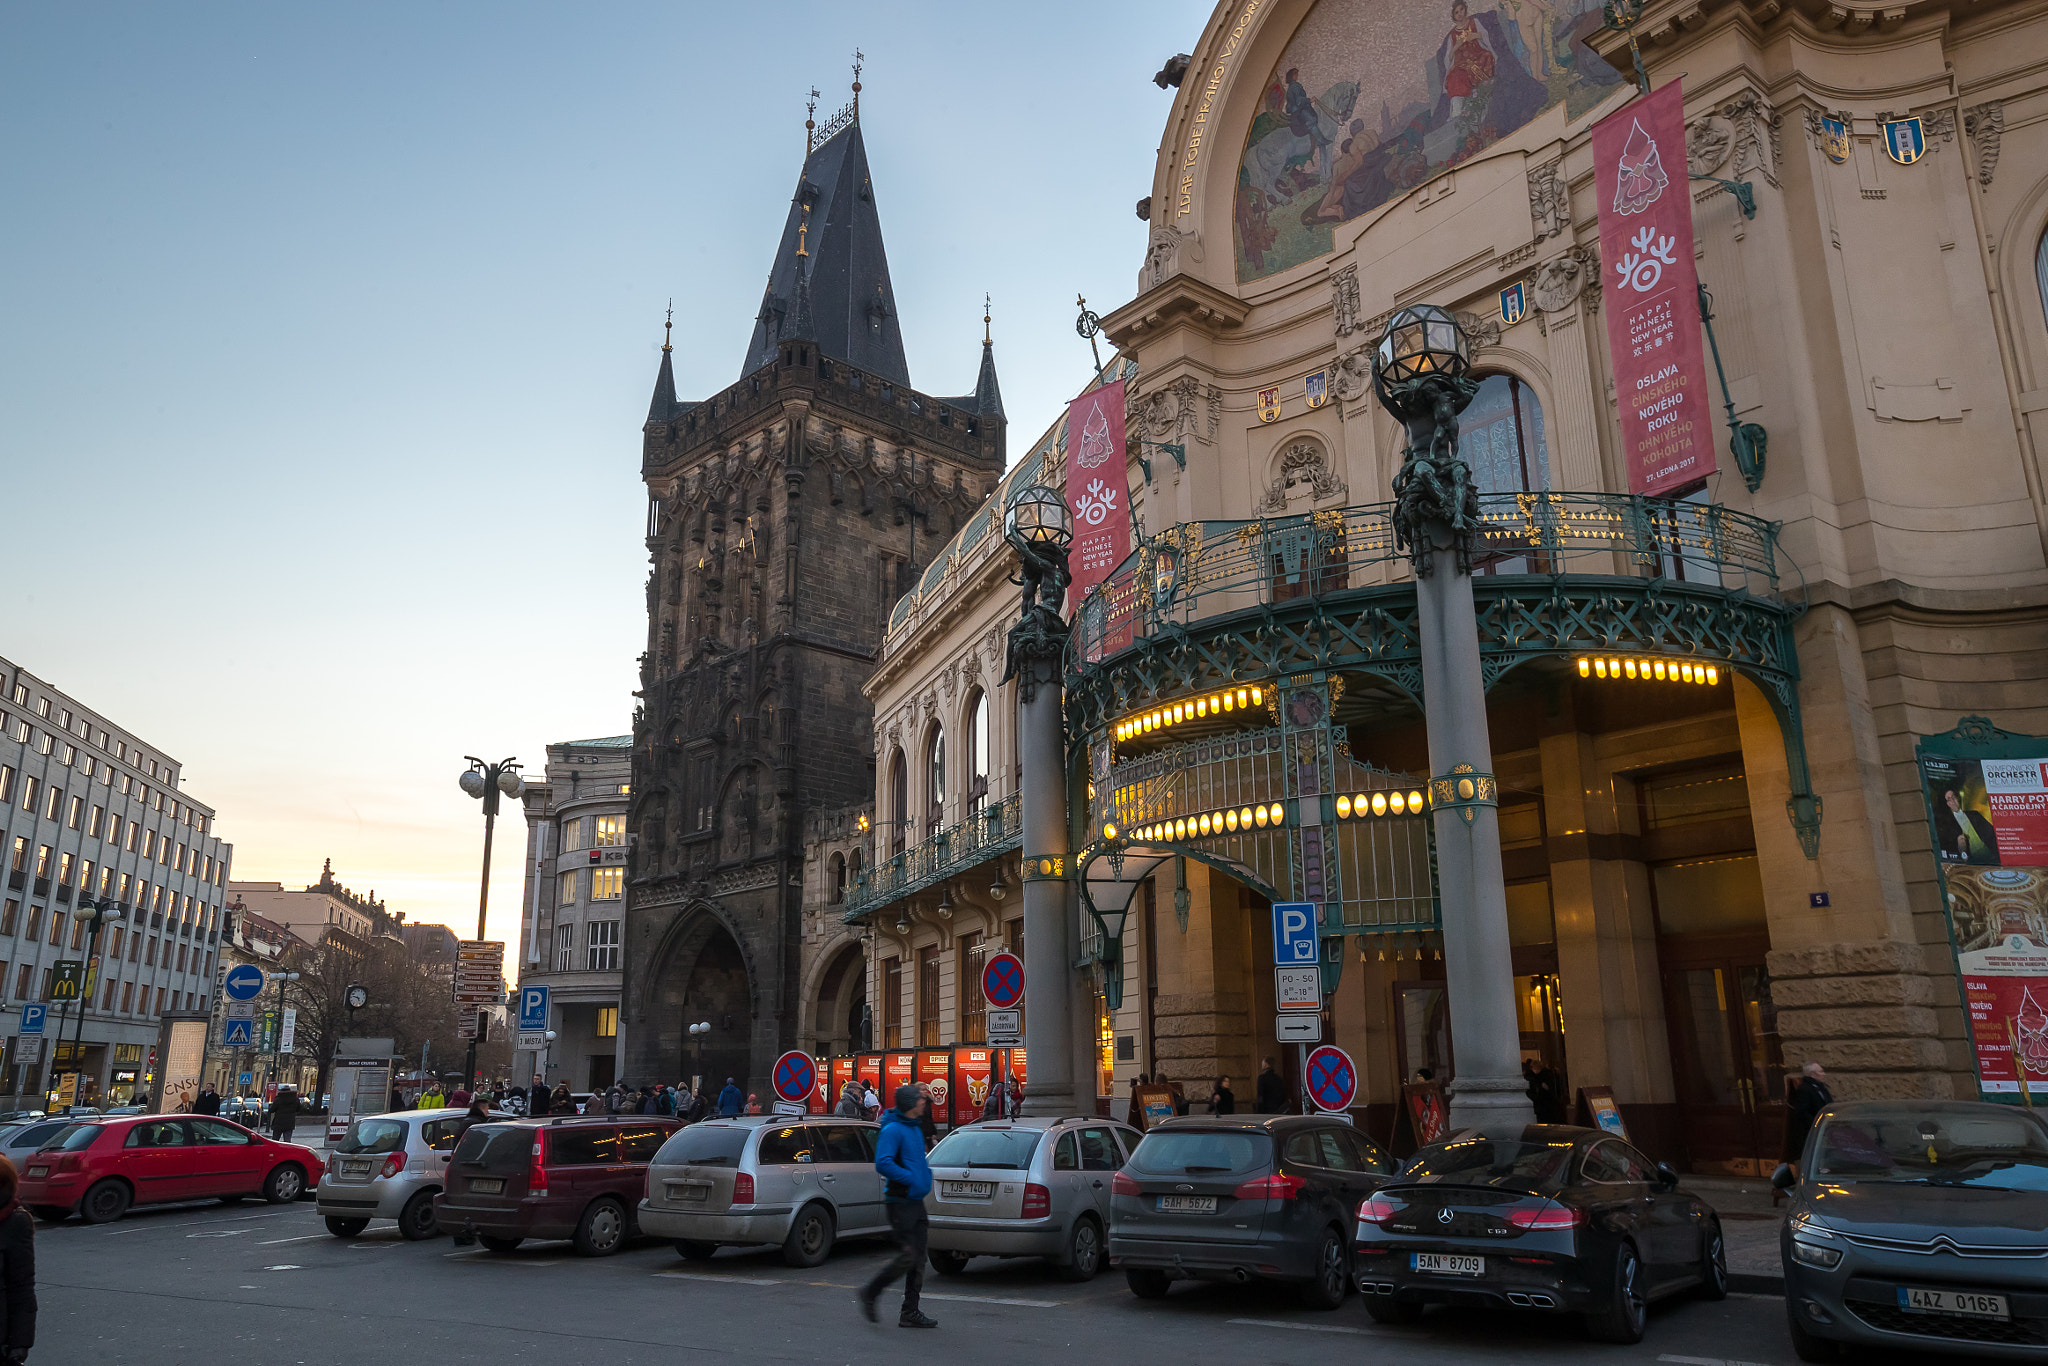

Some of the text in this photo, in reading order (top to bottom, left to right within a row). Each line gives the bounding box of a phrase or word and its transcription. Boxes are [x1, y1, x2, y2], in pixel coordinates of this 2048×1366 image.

[1178, 172, 1194, 218] ZDAR
[1629, 300, 1671, 325] HAPPY
[1630, 310, 1672, 335] CHINESE
[1631, 320, 1673, 345] NEW YEAR
[1636, 363, 1679, 390] OSLAVA
[1632, 375, 1687, 408] ČÍNSKÉHO
[1639, 392, 1683, 420] NOVÉHO
[1648, 410, 1678, 432] ROKU
[1638, 420, 1693, 452] OHNIVÉHO
[1642, 437, 1693, 466] KOHOUTA
[1646, 456, 1695, 483] 27. LEDNA 2017
[1082, 535, 1112, 547] HAPPY
[1082, 542, 1112, 554] CHINESE
[1082, 549, 1113, 562] NEW YEAR
[1990, 795, 2026, 804] HARRY
[605, 852, 624, 860] KB
[1816, 895, 1823, 906] 5
[1282, 910, 1307, 945] P
[526, 991, 542, 1016] P
[1970, 1000, 1993, 1010] NOVÉHO
[26, 1008, 41, 1024] P
[1972, 1012, 1987, 1020] ROKU
[970, 1183, 988, 1193] 1401
[1164, 1197, 1212, 1209] 5AH 5672
[1419, 1254, 1479, 1271] 5AN 8709
[1913, 1291, 2000, 1313] 4AZ 0165
